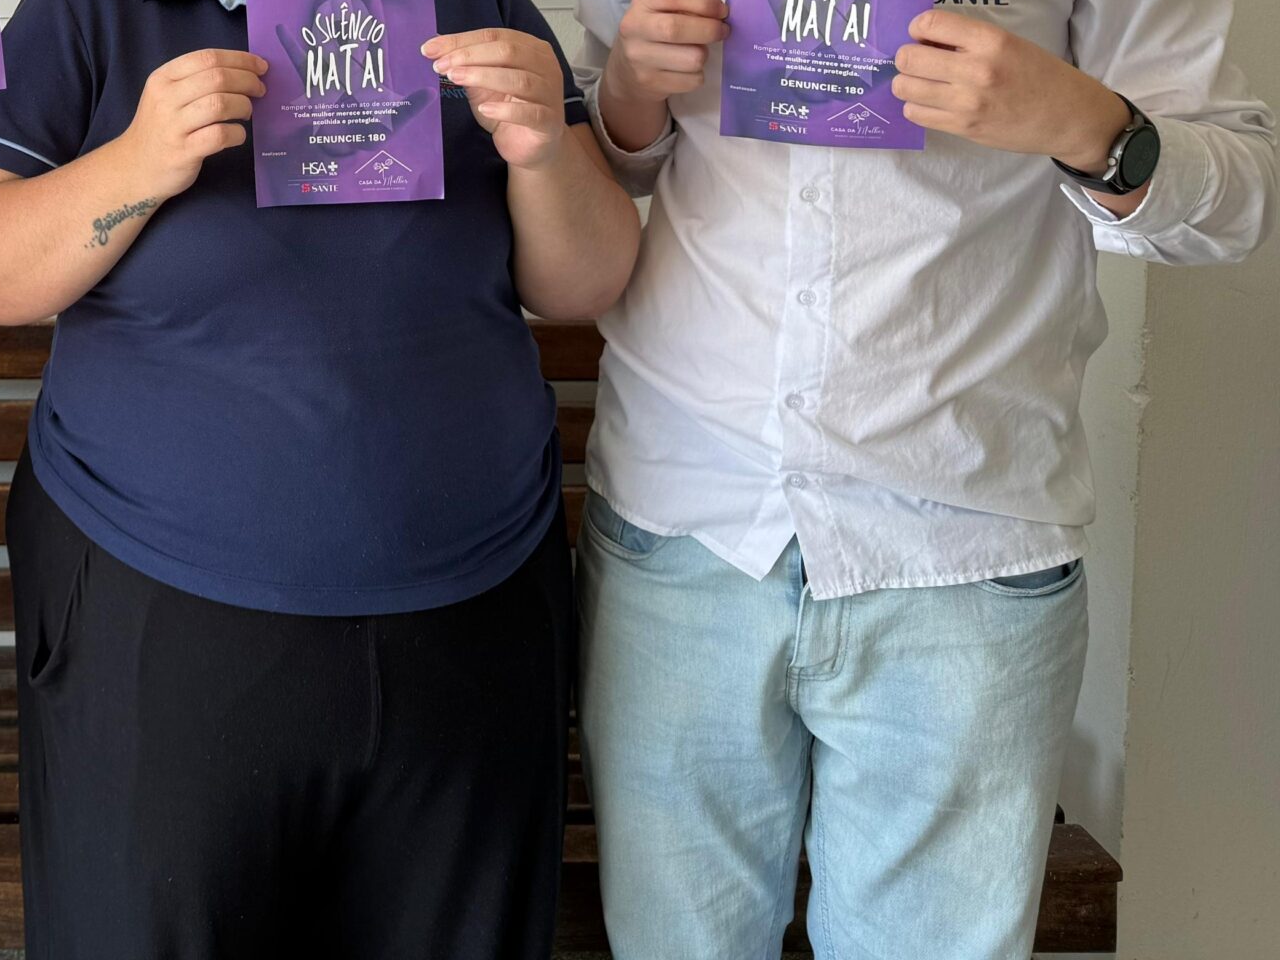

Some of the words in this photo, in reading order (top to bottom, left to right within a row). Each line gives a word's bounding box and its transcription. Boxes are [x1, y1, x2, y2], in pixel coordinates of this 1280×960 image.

[302, 27, 316, 46] O
[315, 2, 384, 43] SILÊNCIO
[766, 53, 783, 61] Toda
[306, 43, 383, 98] MATA!
[785, 64, 815, 72] acolhida
[823, 68, 860, 77] protegida.
[780, 78, 841, 92] DENUNCIE:
[844, 86, 864, 95] 180
[770, 101, 797, 116] HSA
[347, 117, 381, 125] protegida.
[309, 134, 365, 144] DENUNCIE:
[367, 133, 386, 141] 180
[302, 161, 327, 175] HSA
